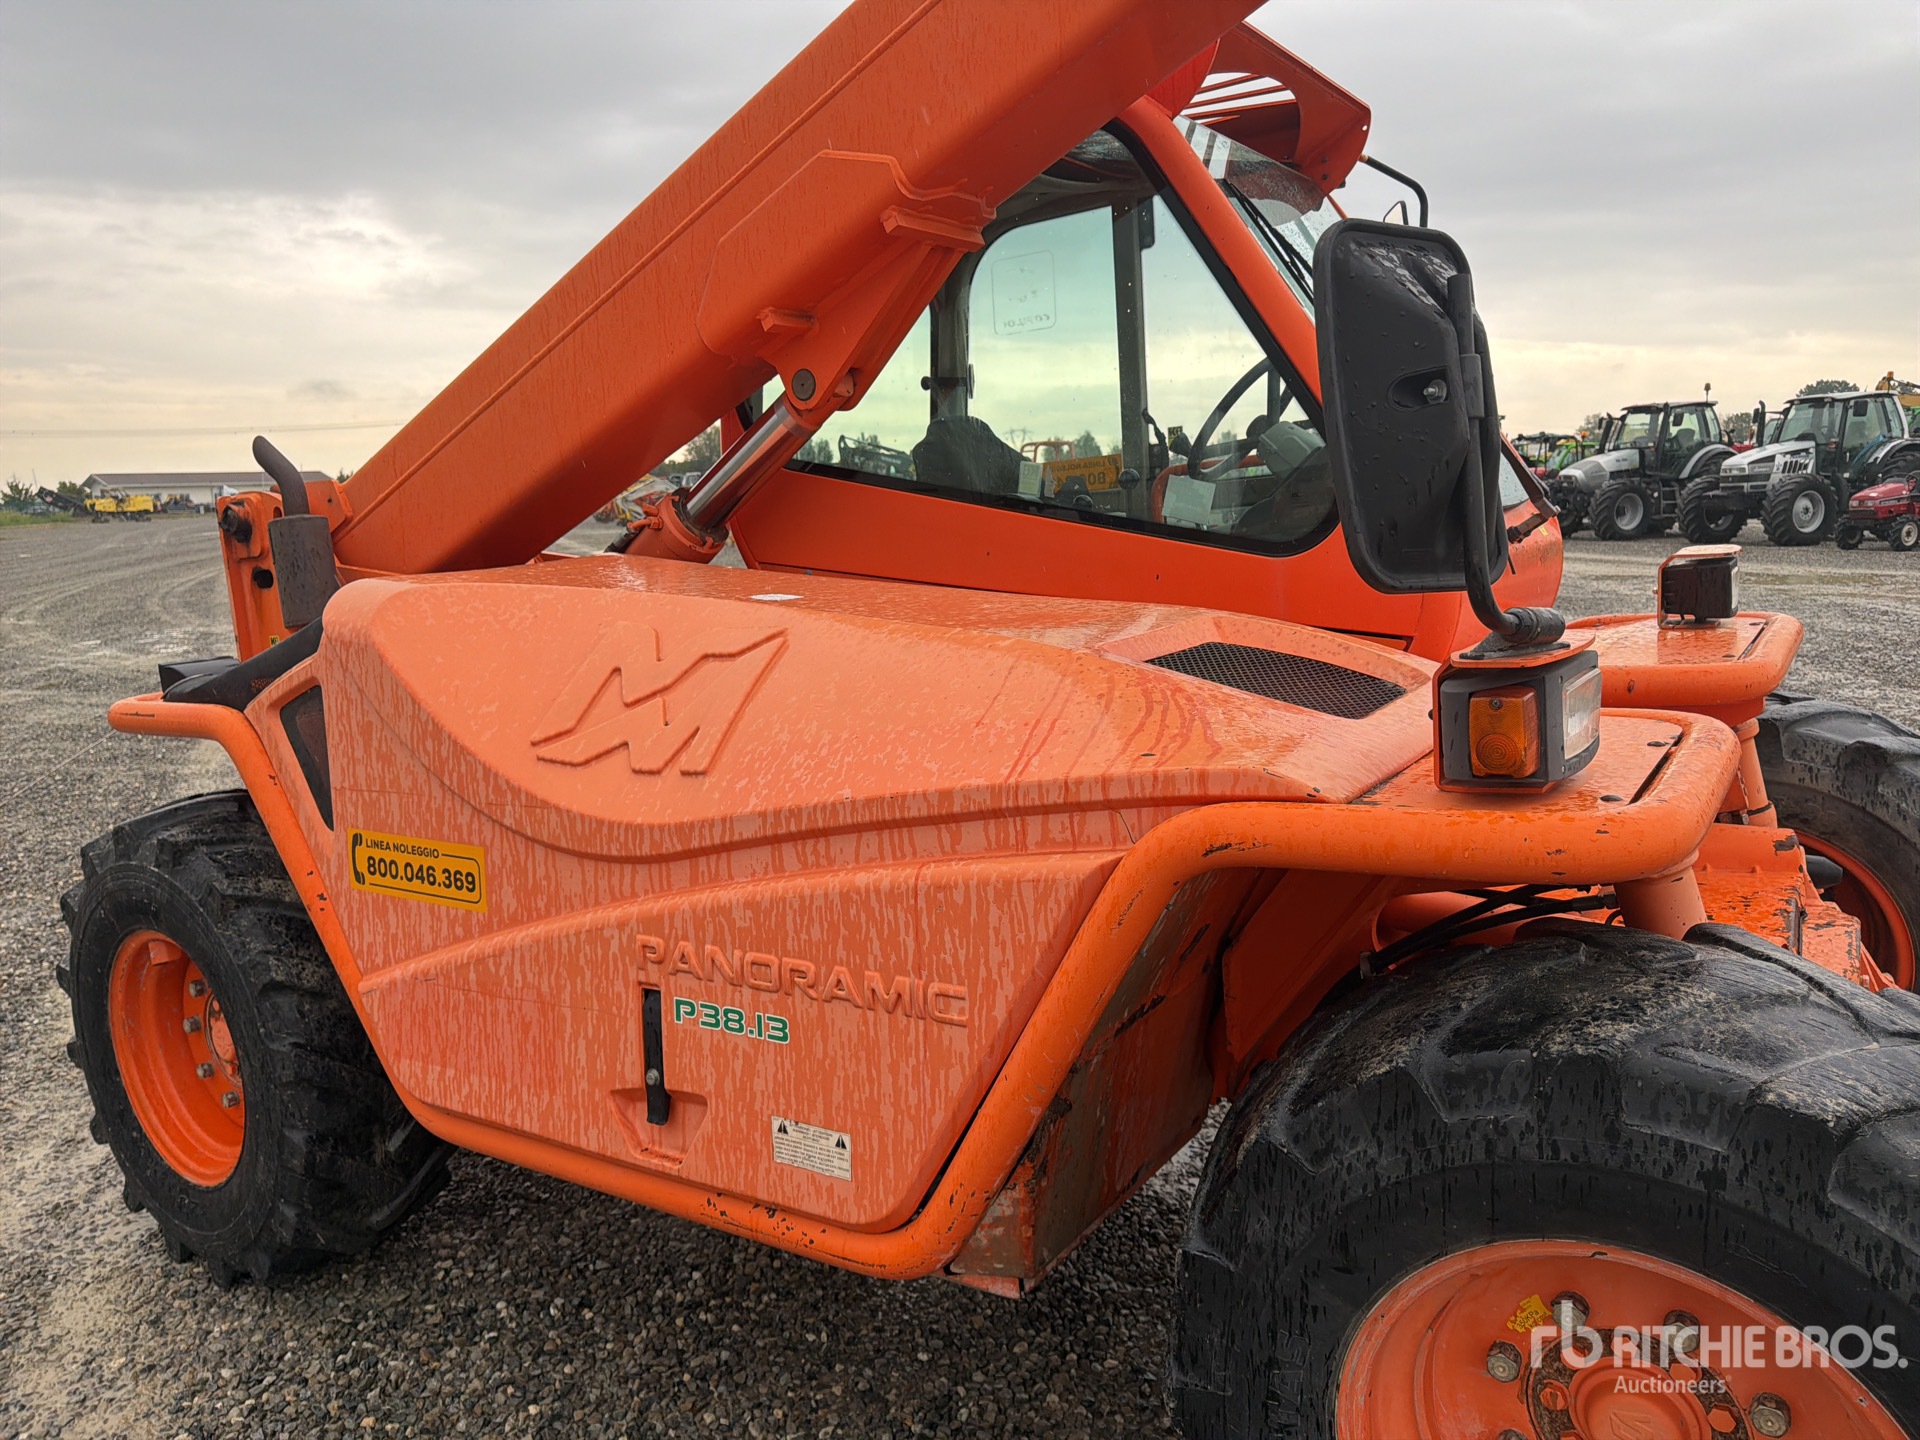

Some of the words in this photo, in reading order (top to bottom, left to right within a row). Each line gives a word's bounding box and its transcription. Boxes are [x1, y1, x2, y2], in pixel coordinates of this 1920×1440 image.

[365, 838, 392, 852] LINEA
[393, 843, 440, 859] NOLEGGIO
[366, 855, 477, 893] 800.046.369
[636, 934, 968, 1027] PANORAMIC
[673, 997, 790, 1044] P38.13
